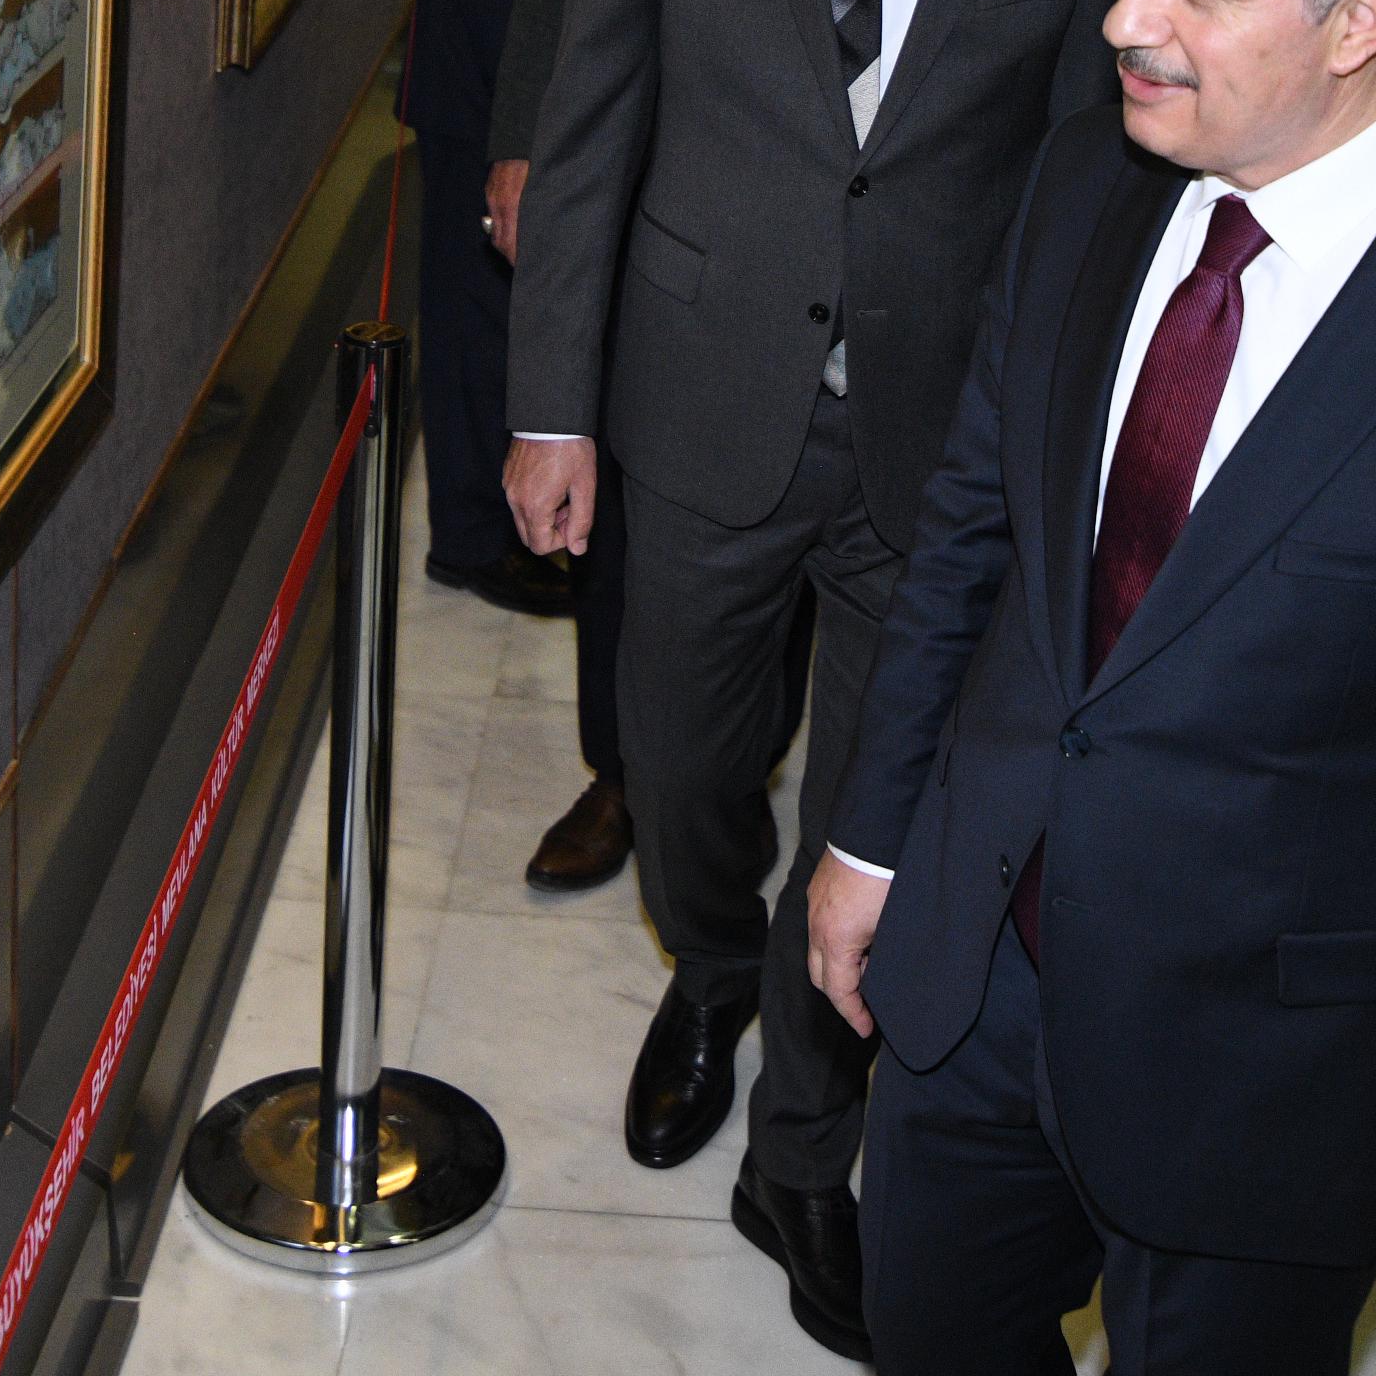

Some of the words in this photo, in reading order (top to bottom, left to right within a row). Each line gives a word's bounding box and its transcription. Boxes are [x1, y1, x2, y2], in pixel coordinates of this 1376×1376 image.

[91, 914, 157, 1115] BELEDİYESİ
[161, 799, 207, 935] MEVLANA
[210, 703, 245, 809] KÜLTÜR
